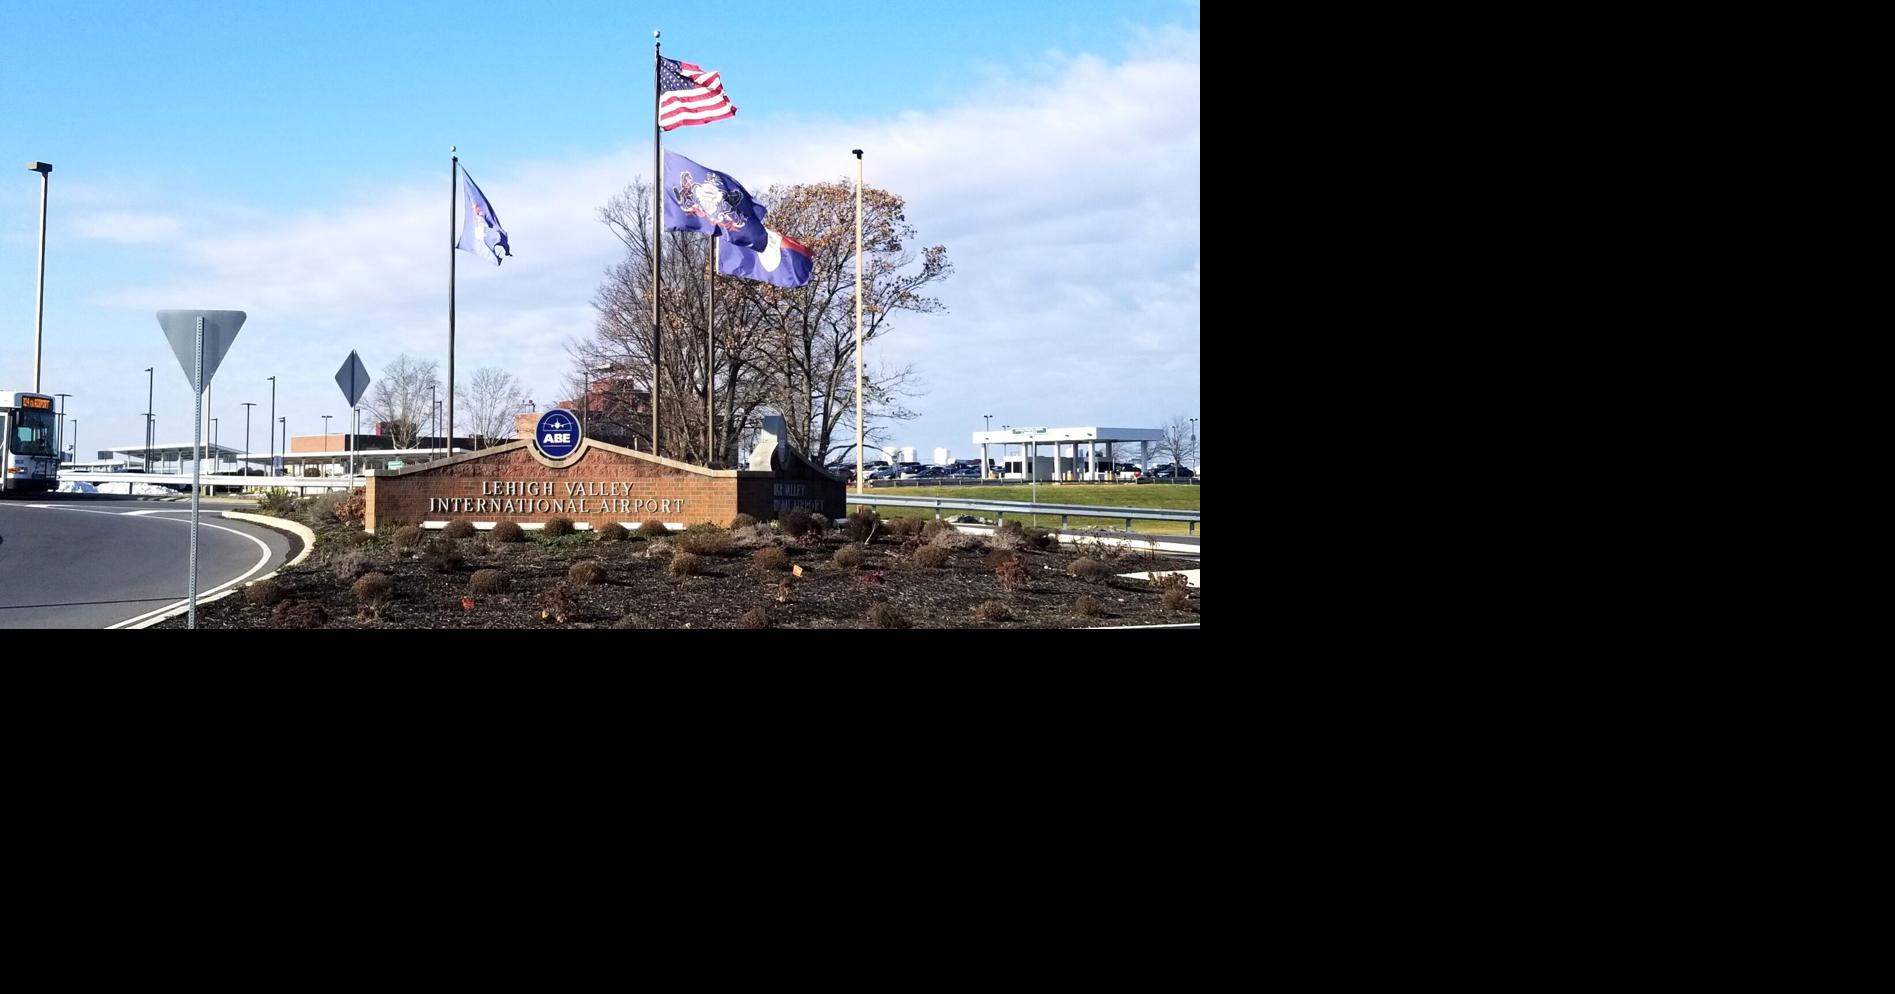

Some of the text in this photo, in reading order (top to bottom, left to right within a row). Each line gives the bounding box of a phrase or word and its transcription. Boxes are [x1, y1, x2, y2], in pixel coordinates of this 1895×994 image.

[543, 433, 571, 443] ABE
[482, 481, 635, 497] LEHIGH VALLEY
[429, 497, 685, 514] INTERNATIONAL AIRPORT
